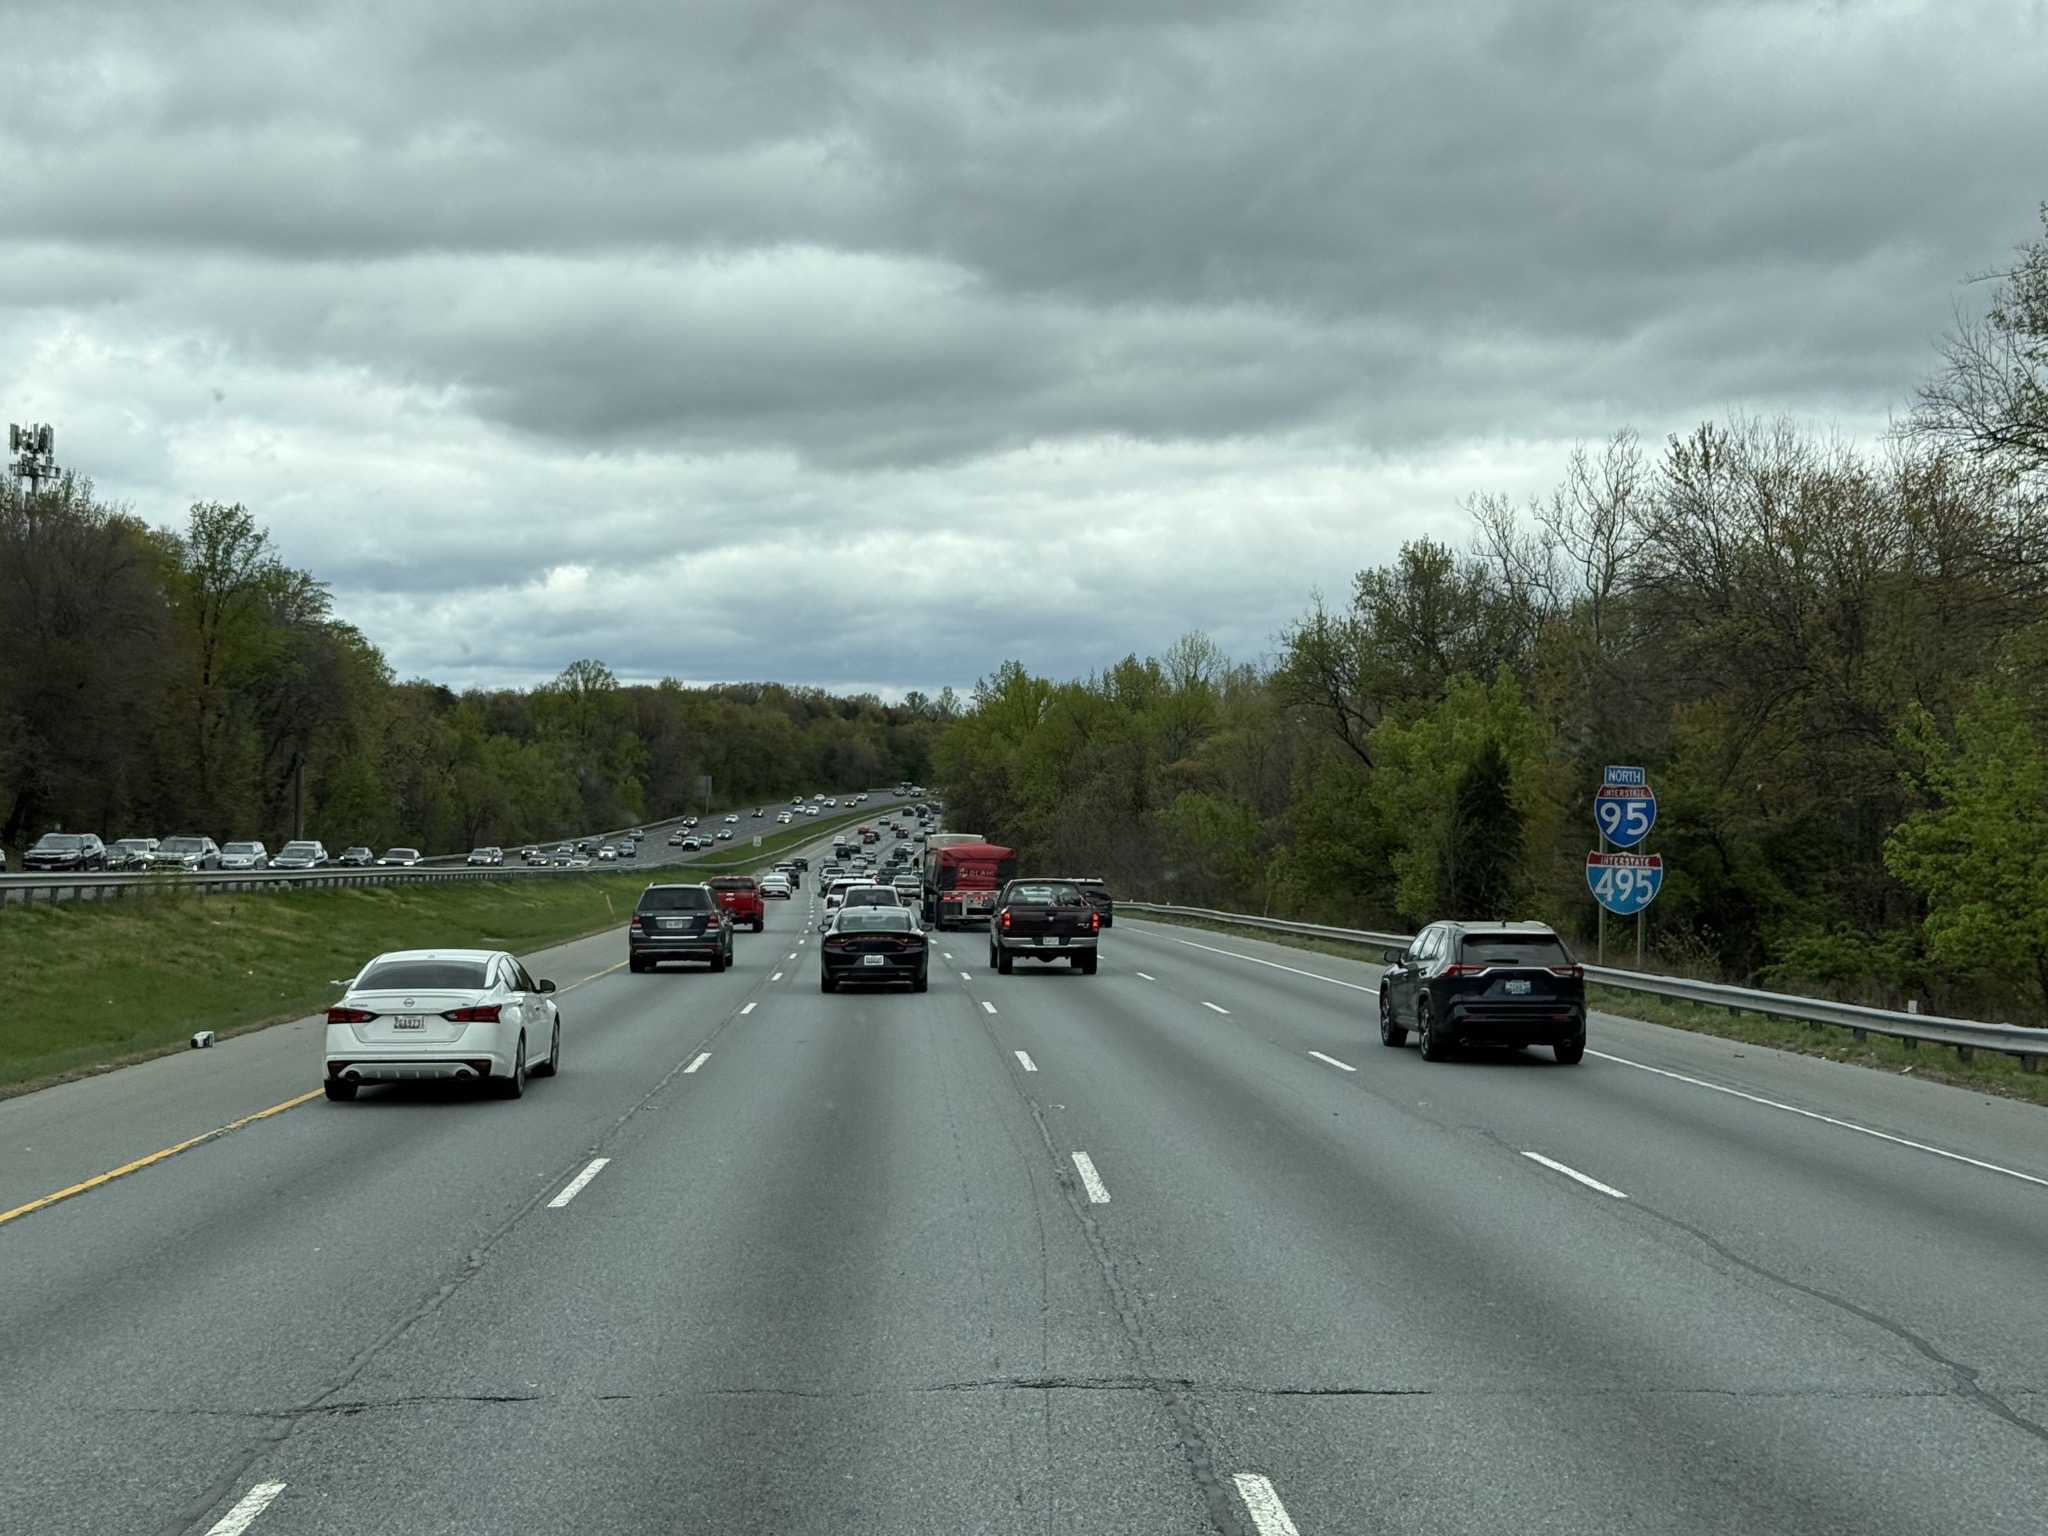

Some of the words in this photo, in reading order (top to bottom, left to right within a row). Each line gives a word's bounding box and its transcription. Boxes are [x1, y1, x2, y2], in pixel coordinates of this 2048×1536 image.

[1608, 769, 1641, 784] NORTH
[1604, 788, 1646, 798] INTERSTATE
[1600, 802, 1649, 836] 95
[1601, 855, 1650, 867] INTERSTATE
[1595, 868, 1653, 904] 495
